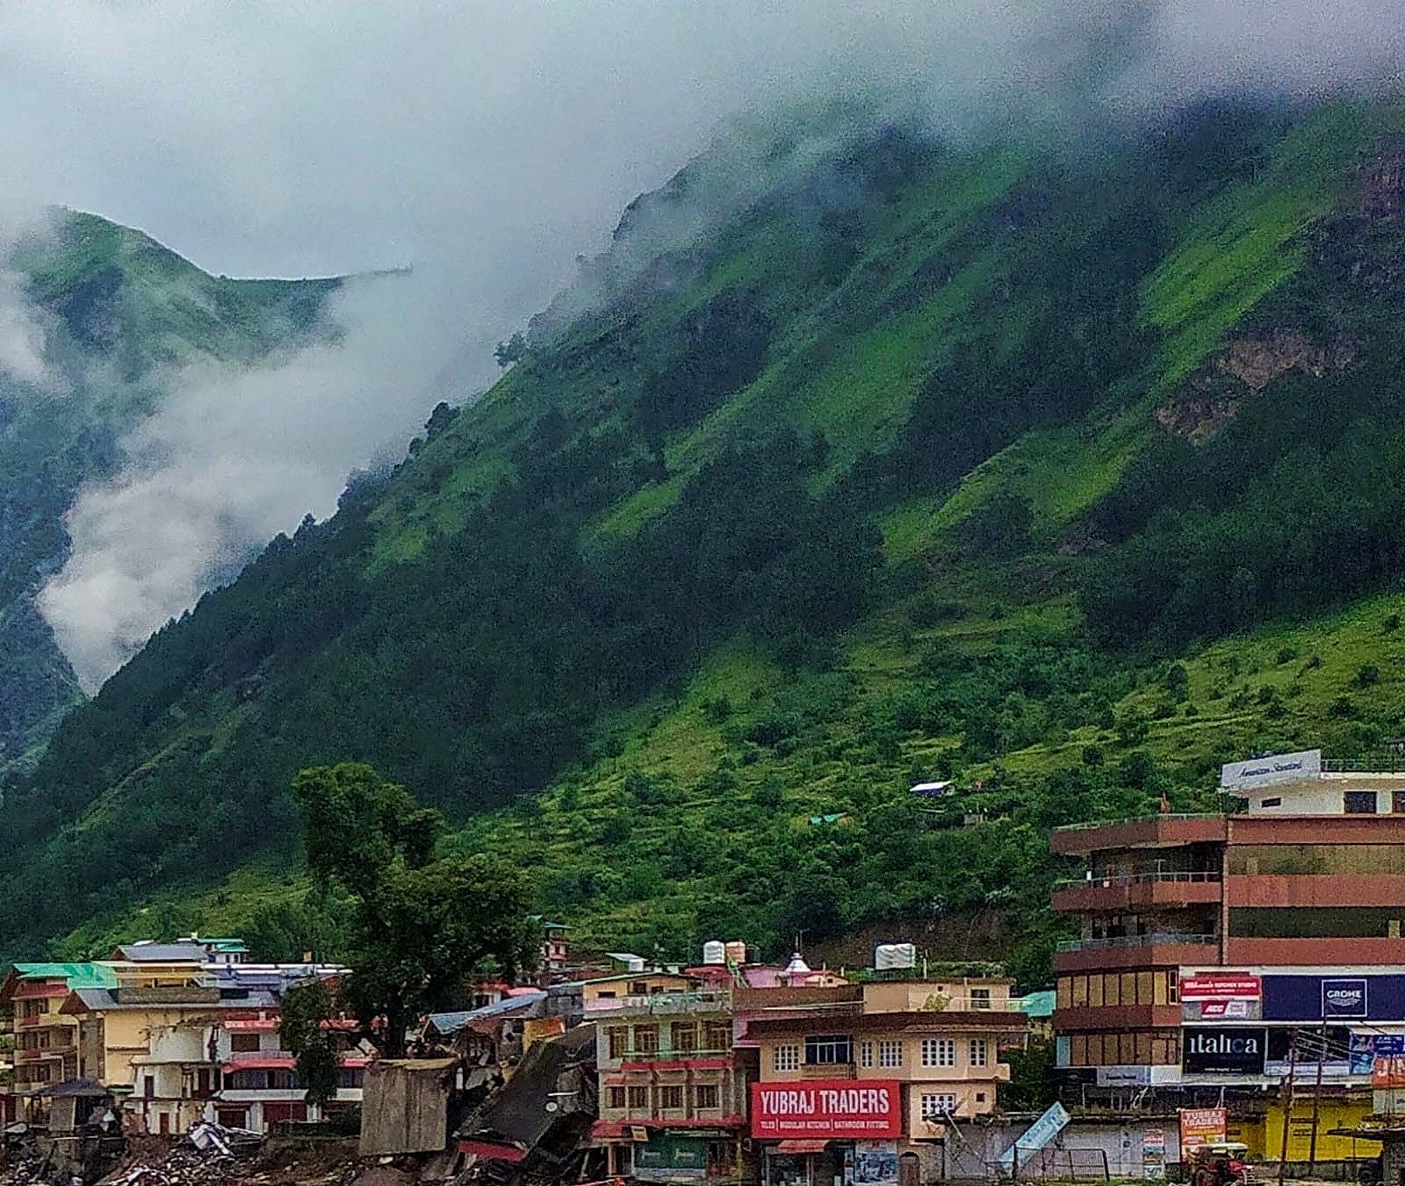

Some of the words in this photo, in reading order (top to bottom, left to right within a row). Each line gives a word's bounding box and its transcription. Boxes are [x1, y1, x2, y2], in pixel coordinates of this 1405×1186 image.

[1327, 990, 1362, 999] GROHE
[1189, 1034, 1259, 1054] italica
[760, 1090, 815, 1115] YUBRAJ
[819, 1088, 890, 1114] TRADERS
